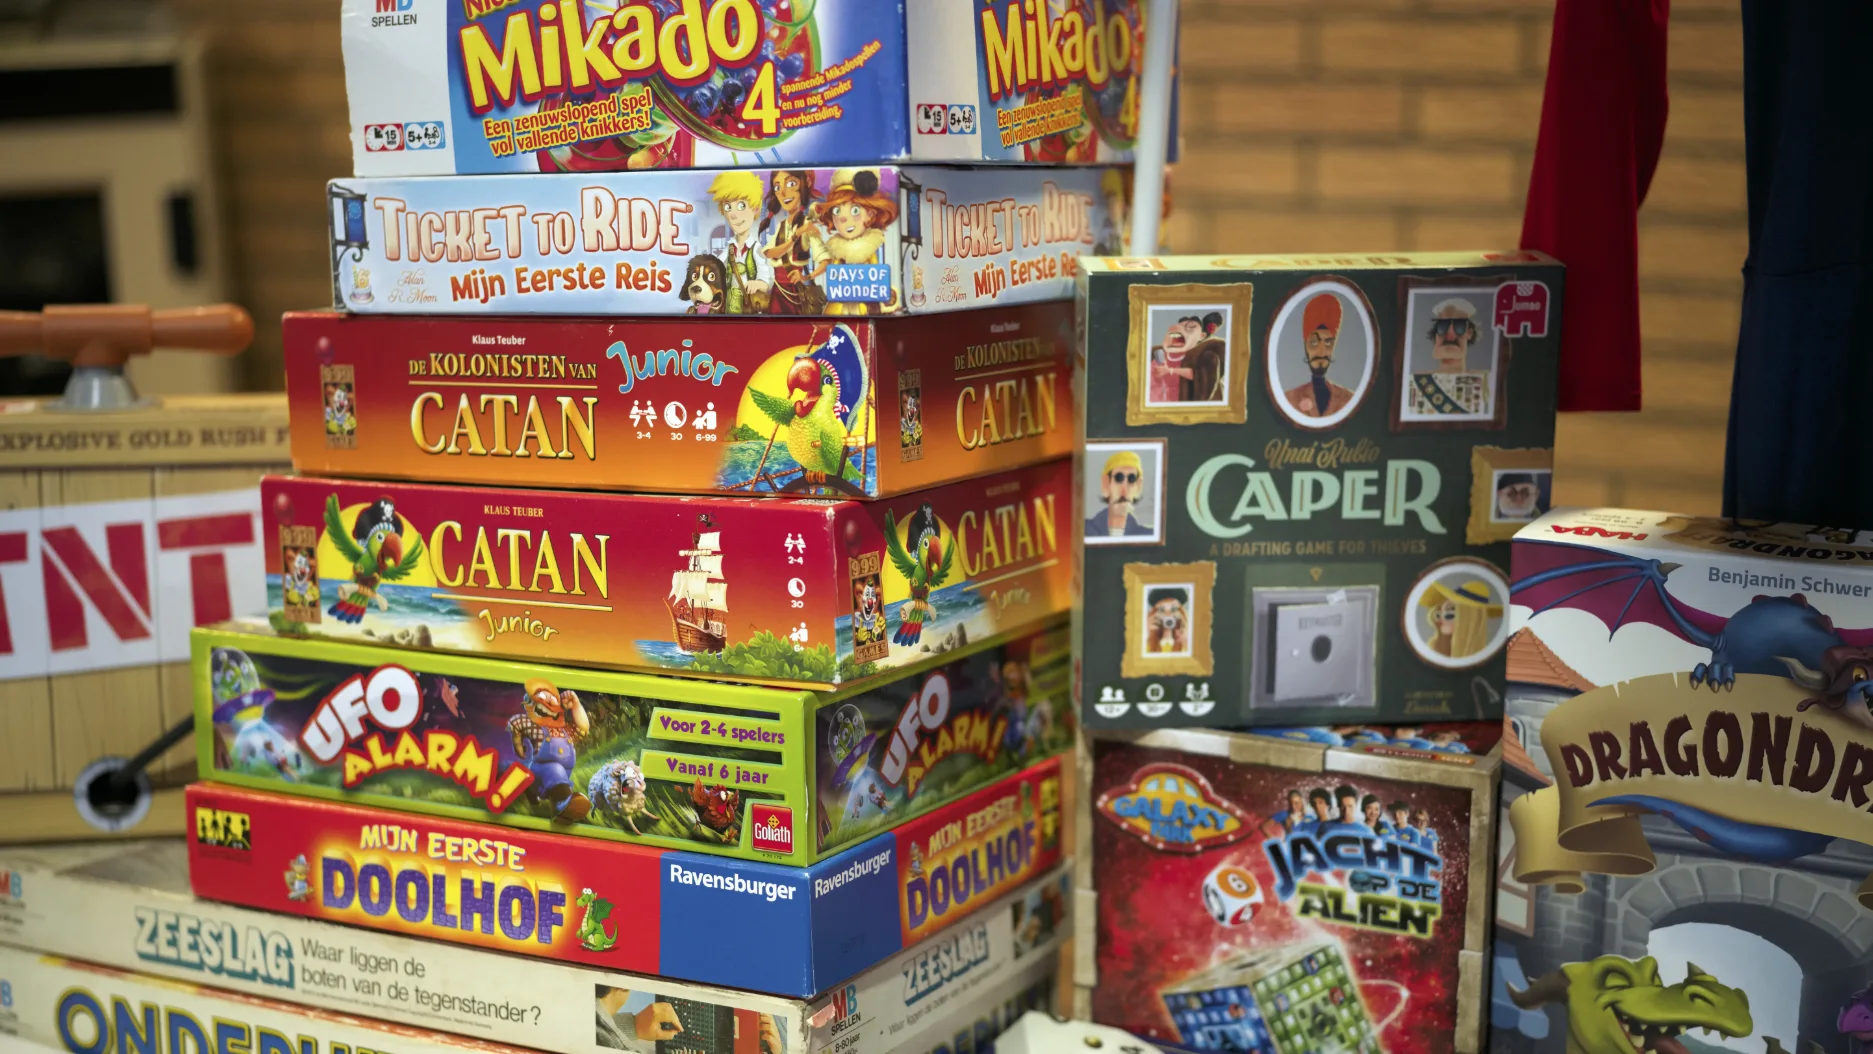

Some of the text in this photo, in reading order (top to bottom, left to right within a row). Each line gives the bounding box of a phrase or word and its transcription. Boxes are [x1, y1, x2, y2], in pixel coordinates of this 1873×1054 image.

[371, 14, 418, 27] SPELLEN
[460, 0, 760, 108] Mikado
[981, 0, 1132, 95] Mikado
[781, 40, 881, 96] spannende Mikadospellen
[484, 88, 652, 137] Een zenuwslopend spel
[742, 61, 781, 134] 4
[781, 79, 852, 110] en nu nog minder
[1118, 75, 1137, 137] 4
[491, 110, 650, 155] vol vallende knikkers!
[932, 110, 942, 121] 15
[949, 113, 961, 126] 5+
[997, 109, 1011, 127] Een
[1001, 128, 1013, 146] vol
[1014, 119, 1045, 142] vallende
[385, 129, 397, 140] 15
[408, 131, 423, 143] 5+
[373, 196, 527, 263] TICKET
[531, 211, 576, 256] TO
[926, 181, 1095, 259] TICKET TO RIDE
[450, 260, 673, 304] Mijn Eerste Reis
[829, 267, 888, 282] DAYS OF
[829, 284, 888, 299] WONDER
[973, 251, 1080, 299] Mijn Eerste Re
[472, 335, 526, 346] Klaus Teuber
[954, 355, 965, 370] DE
[967, 337, 1040, 368] KOLONISTEN
[409, 352, 597, 379] DE KOLONISTEN VAN
[606, 339, 739, 394] Junior
[410, 391, 599, 461] CATAN
[956, 372, 1057, 451] CATAN
[0, 429, 122, 450] XPLOSIVE
[129, 428, 193, 449] GOLD
[202, 426, 267, 448] RUSH
[636, 431, 651, 439] 3-4
[671, 432, 683, 440] 30
[695, 433, 717, 442] 6-99
[1264, 437, 1380, 470] Unai Rubio
[484, 505, 544, 518] KLAUS TEUBER
[1186, 453, 1448, 539] CAPER
[958, 494, 1056, 577] CATAN
[1209, 539, 1428, 557] A DRAFTING GAME FOR THIEVES
[1550, 525, 1649, 541] HABA
[429, 520, 610, 599] CATAN
[788, 556, 804, 565] 2-4
[851, 556, 878, 577] 999
[1708, 566, 1872, 598] Benjamin Schwer
[791, 600, 804, 608] 30
[478, 608, 559, 642] Junior
[793, 644, 805, 653] 6+
[857, 643, 886, 659] GAMES
[300, 665, 421, 763] UFO
[659, 714, 785, 745] Voor 2-4 spelers
[880, 673, 950, 785] UFO
[344, 730, 532, 810] ALARM!
[666, 757, 769, 785] Vanaf 6 jaar
[907, 710, 1008, 797] ALARM!
[1559, 711, 1873, 814] DRAGONDR
[1113, 796, 1230, 831] GALAXY
[360, 824, 526, 871] MIJN EERSTE
[928, 819, 963, 858] MIJN
[669, 864, 796, 902] Ravensburger
[814, 848, 892, 898] Ravensburger
[907, 820, 1036, 931] DOOLHOF
[1265, 833, 1441, 901] JACHT
[321, 855, 566, 945] DOOLHOF
[1397, 879, 1437, 901] DE
[1298, 884, 1440, 937] ALIEN
[134, 905, 295, 989] ZEESLAG
[301, 937, 426, 978] Waar liggen de
[901, 922, 989, 1007] ZEESLAG
[302, 964, 347, 990] boten
[352, 977, 382, 997] van
[388, 981, 409, 1001] de
[832, 984, 858, 1023] MB
[831, 1012, 861, 1037] SPELLEN
[849, 1032, 861, 1047] jaar
